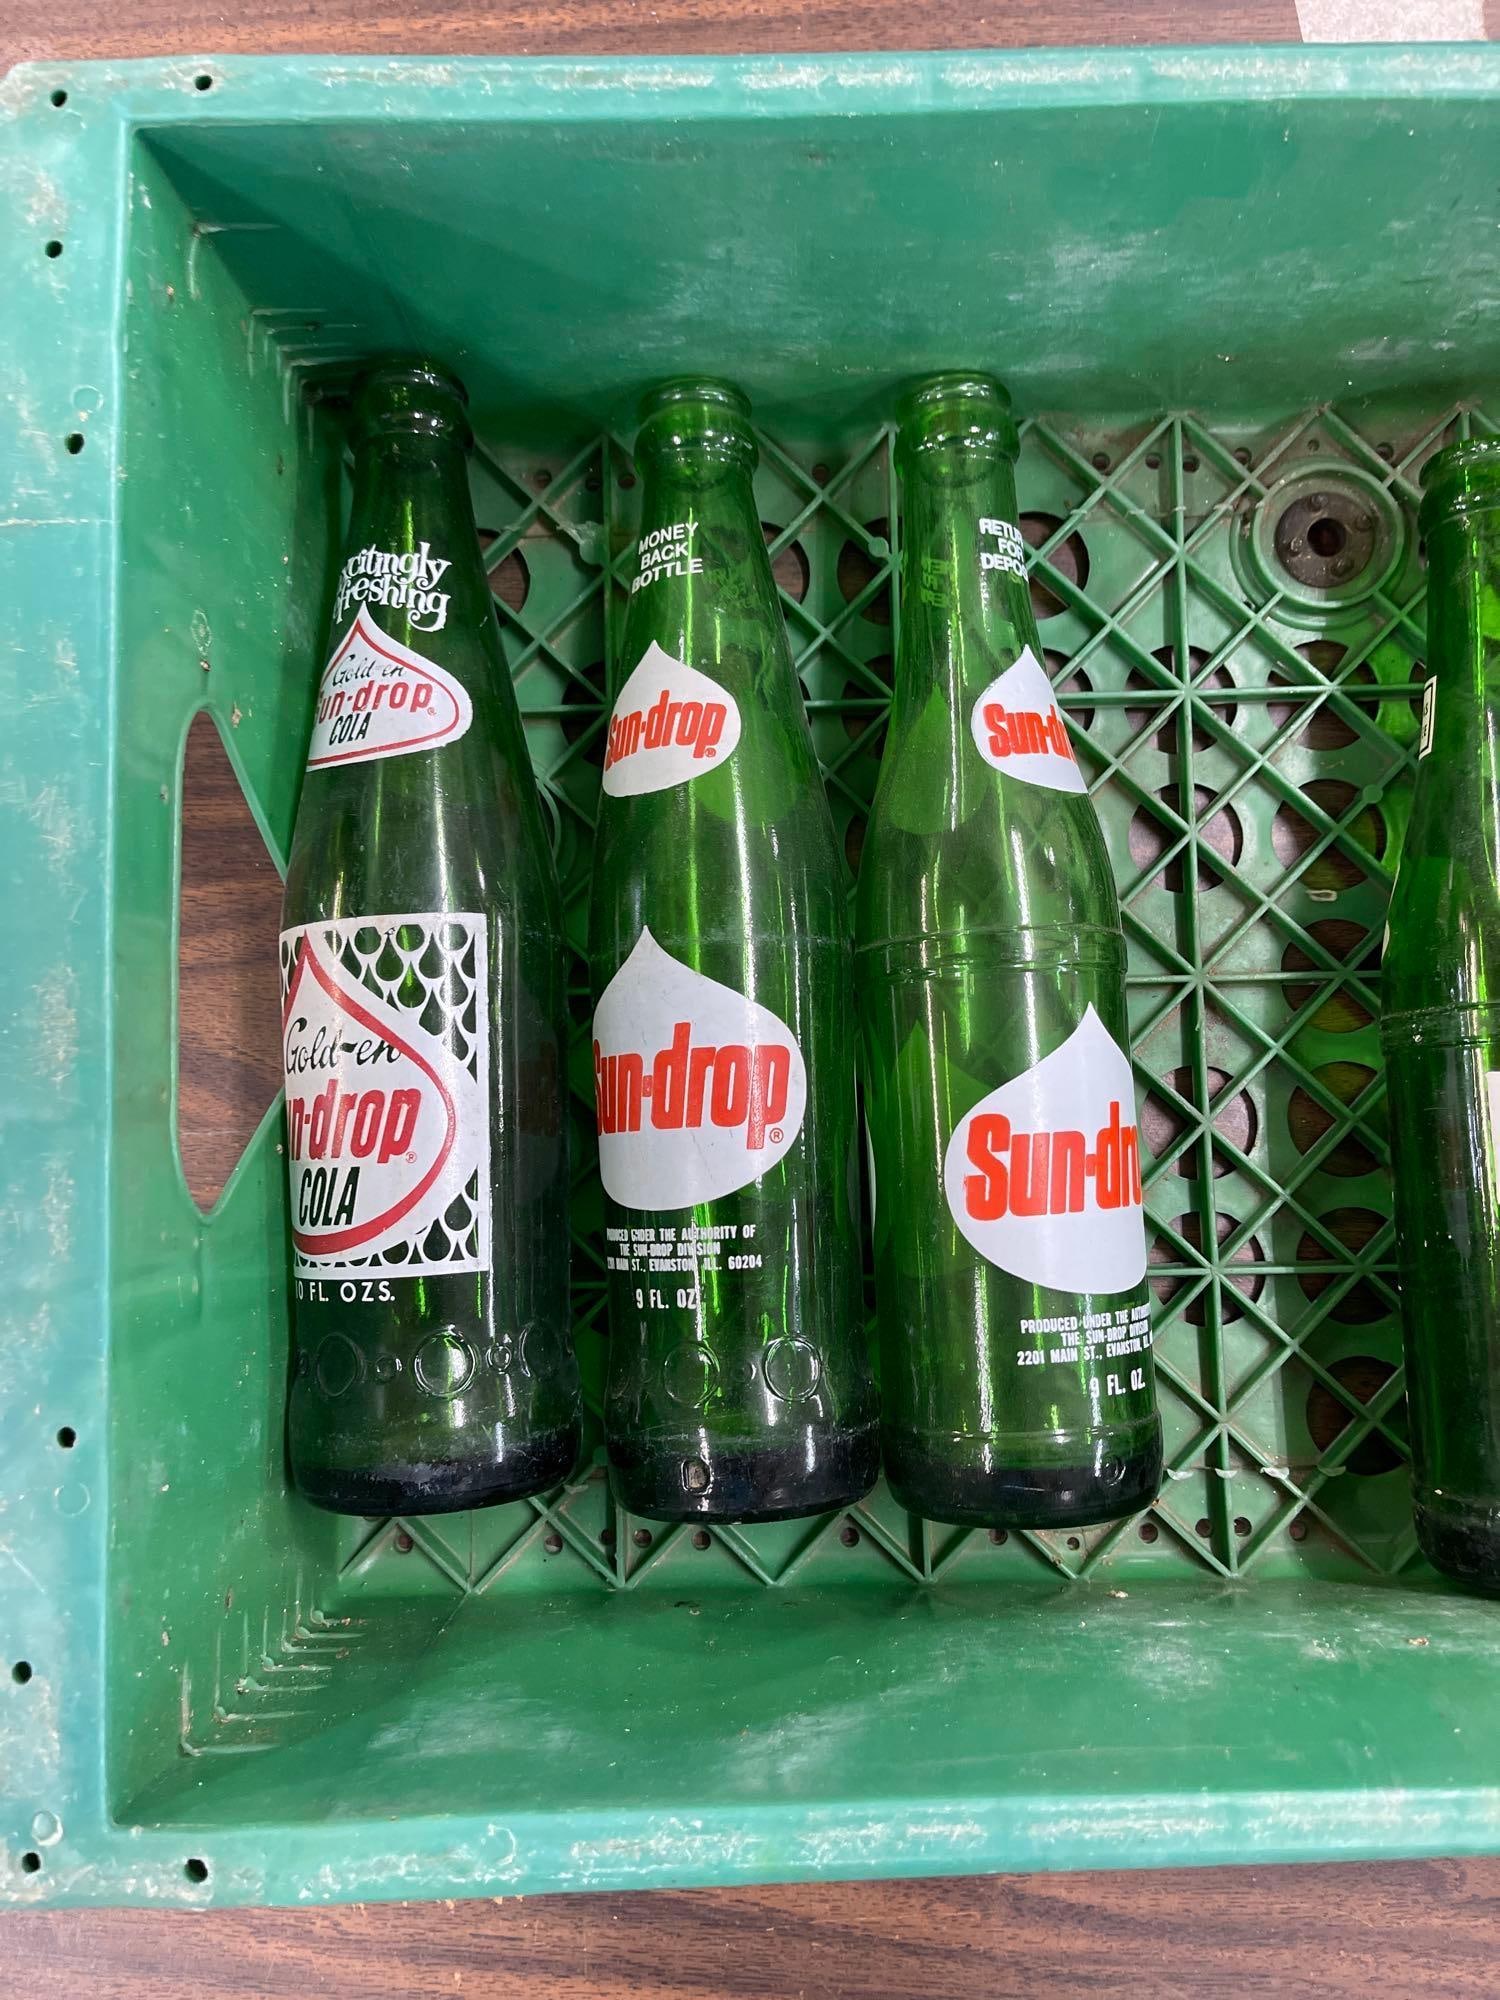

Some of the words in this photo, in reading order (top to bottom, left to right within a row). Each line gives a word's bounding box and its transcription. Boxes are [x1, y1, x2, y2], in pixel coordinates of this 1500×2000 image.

[638, 521, 699, 555] MONEY
[997, 537, 1025, 565] FOR
[640, 541, 689, 571] BACK
[631, 557, 704, 594] BOTTLE
[328, 711, 373, 747] COLA
[604, 689, 728, 773] Sun-drop
[286, 1016, 403, 1075] Gold-en
[298, 1166, 361, 1229] COLA
[659, 1228, 676, 1241] THE
[681, 1225, 738, 1241] AUTHORITY
[742, 1224, 757, 1238] OF
[677, 1241, 721, 1257] DIVISION
[727, 1254, 763, 1270] 60204
[309, 1281, 330, 1302] FL.
[340, 1280, 396, 1303] OZS.
[635, 1288, 644, 1309] 9
[649, 1288, 670, 1309] FL.
[1020, 1315, 1078, 1334] PRODUCED
[1082, 1312, 1112, 1329] UNDER
[1114, 1308, 1130, 1325] THE
[1060, 1331, 1081, 1347] THE
[1085, 1324, 1127, 1345] SUN-DROP
[1016, 1349, 1046, 1366] 2201
[1050, 1347, 1079, 1364] MAIN
[1089, 1376, 1100, 1399] 9
[1106, 1373, 1127, 1396] FL.
[1130, 1367, 1146, 1391] OZ.
